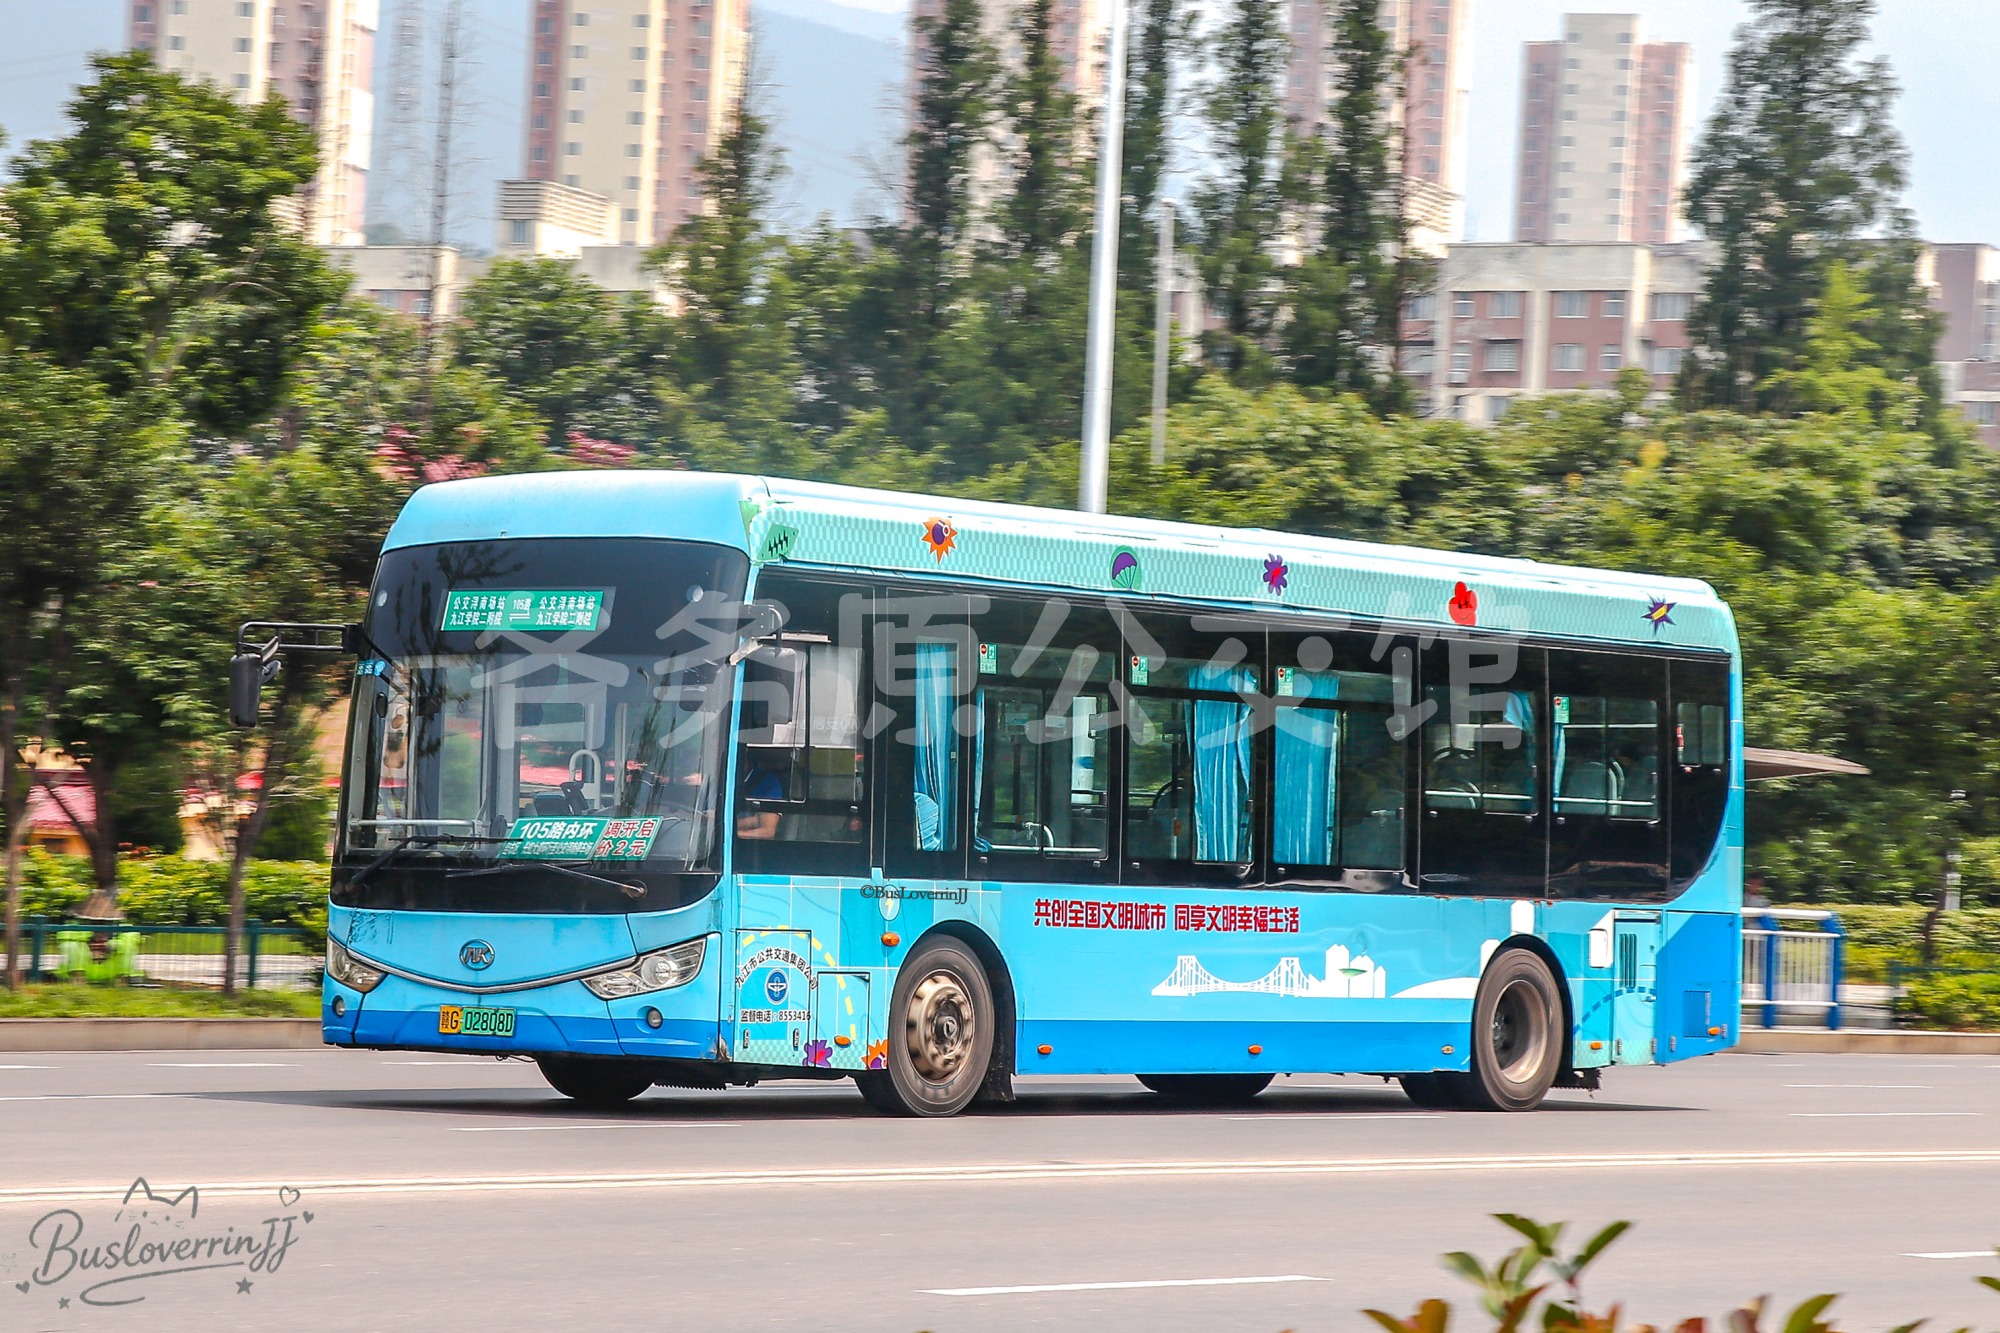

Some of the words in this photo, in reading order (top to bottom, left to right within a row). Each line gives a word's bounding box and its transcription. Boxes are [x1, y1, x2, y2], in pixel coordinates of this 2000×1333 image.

[519, 821, 598, 840] 105路内环
[1034, 898, 1167, 930] 共创全国文明城市
[1173, 903, 1300, 933] 同享文明幸福生活
